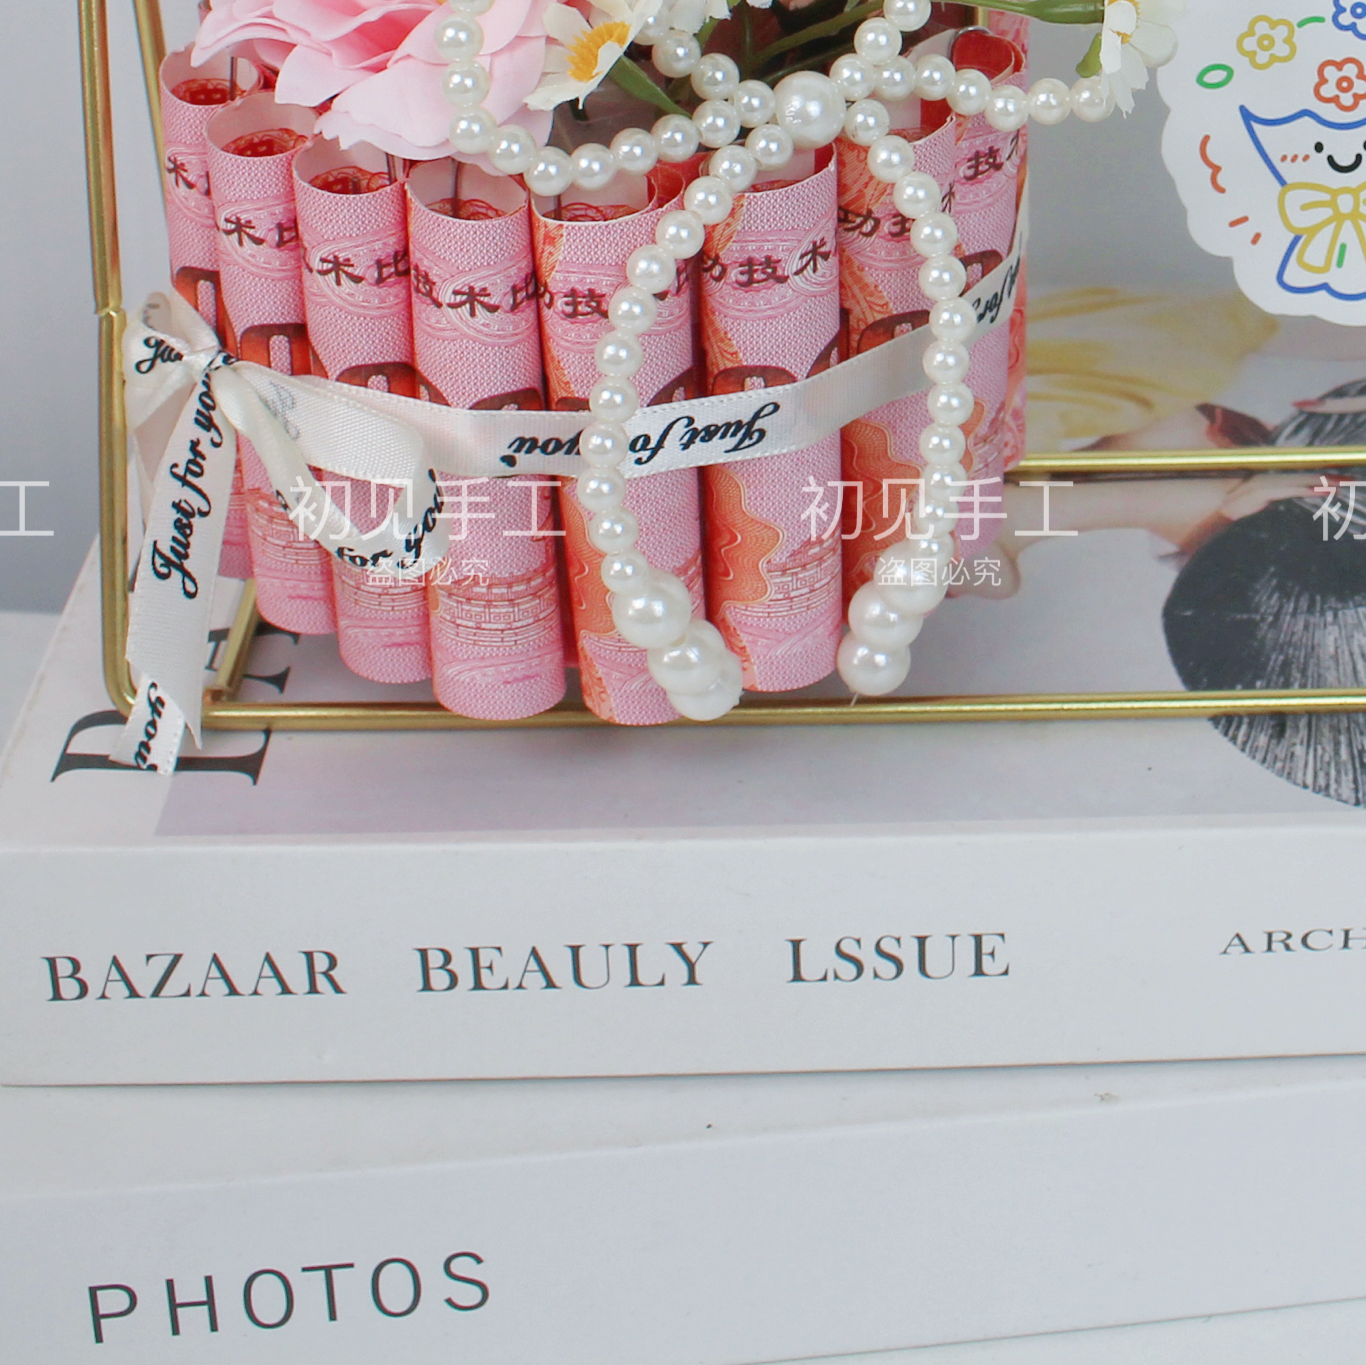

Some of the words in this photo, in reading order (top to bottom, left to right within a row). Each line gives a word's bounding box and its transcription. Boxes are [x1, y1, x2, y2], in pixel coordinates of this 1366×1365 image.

[628, 415, 695, 466] fo
[679, 401, 780, 454] Just
[169, 437, 213, 518] for
[151, 498, 200, 601] Just
[43, 950, 346, 1002] BAZAAR
[414, 941, 712, 993] BEAULY
[786, 932, 1010, 984] LSSUE
[87, 1251, 490, 1344] PHOTOS
